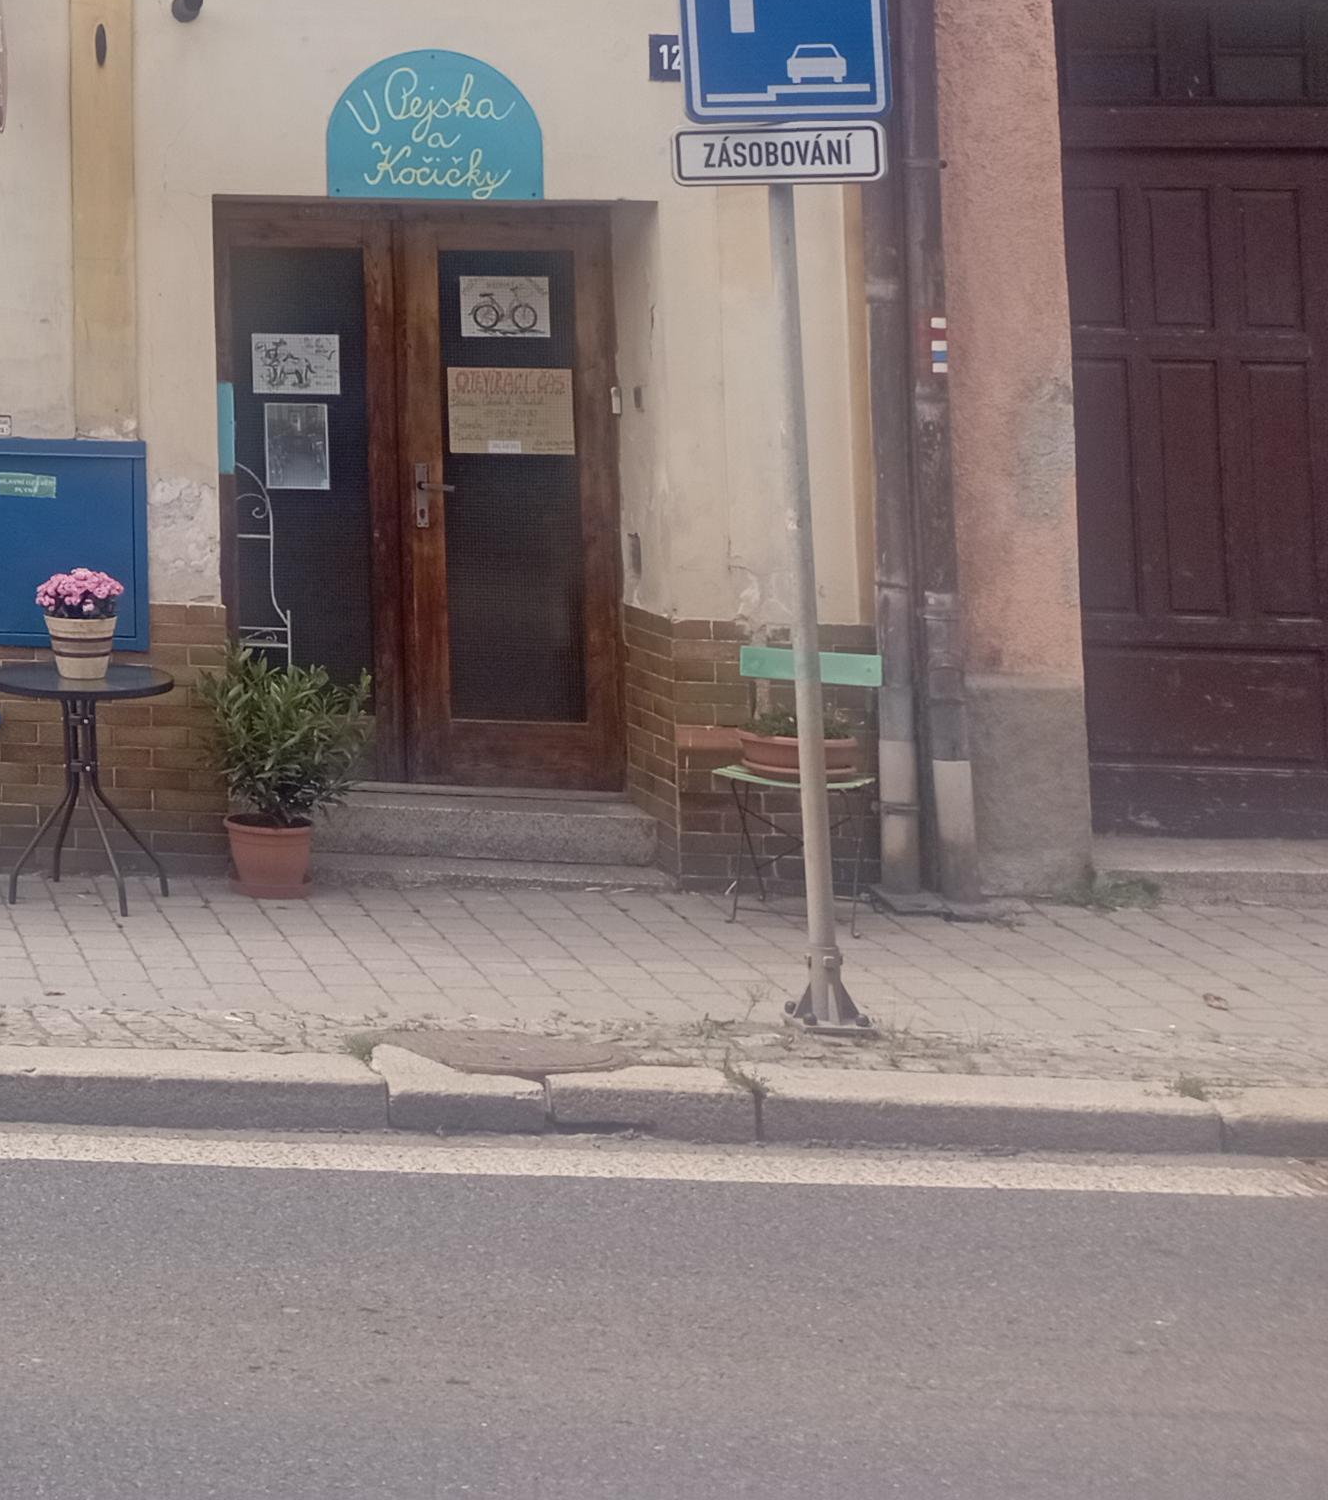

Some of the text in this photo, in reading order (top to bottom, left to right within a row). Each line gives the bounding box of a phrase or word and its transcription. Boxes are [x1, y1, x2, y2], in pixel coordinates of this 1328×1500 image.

[346, 67, 516, 143] U Pejska
[427, 132, 462, 149] a
[702, 132, 853, 169] ZÁSOBOVÁNÍ
[363, 141, 512, 200] Kočičky
